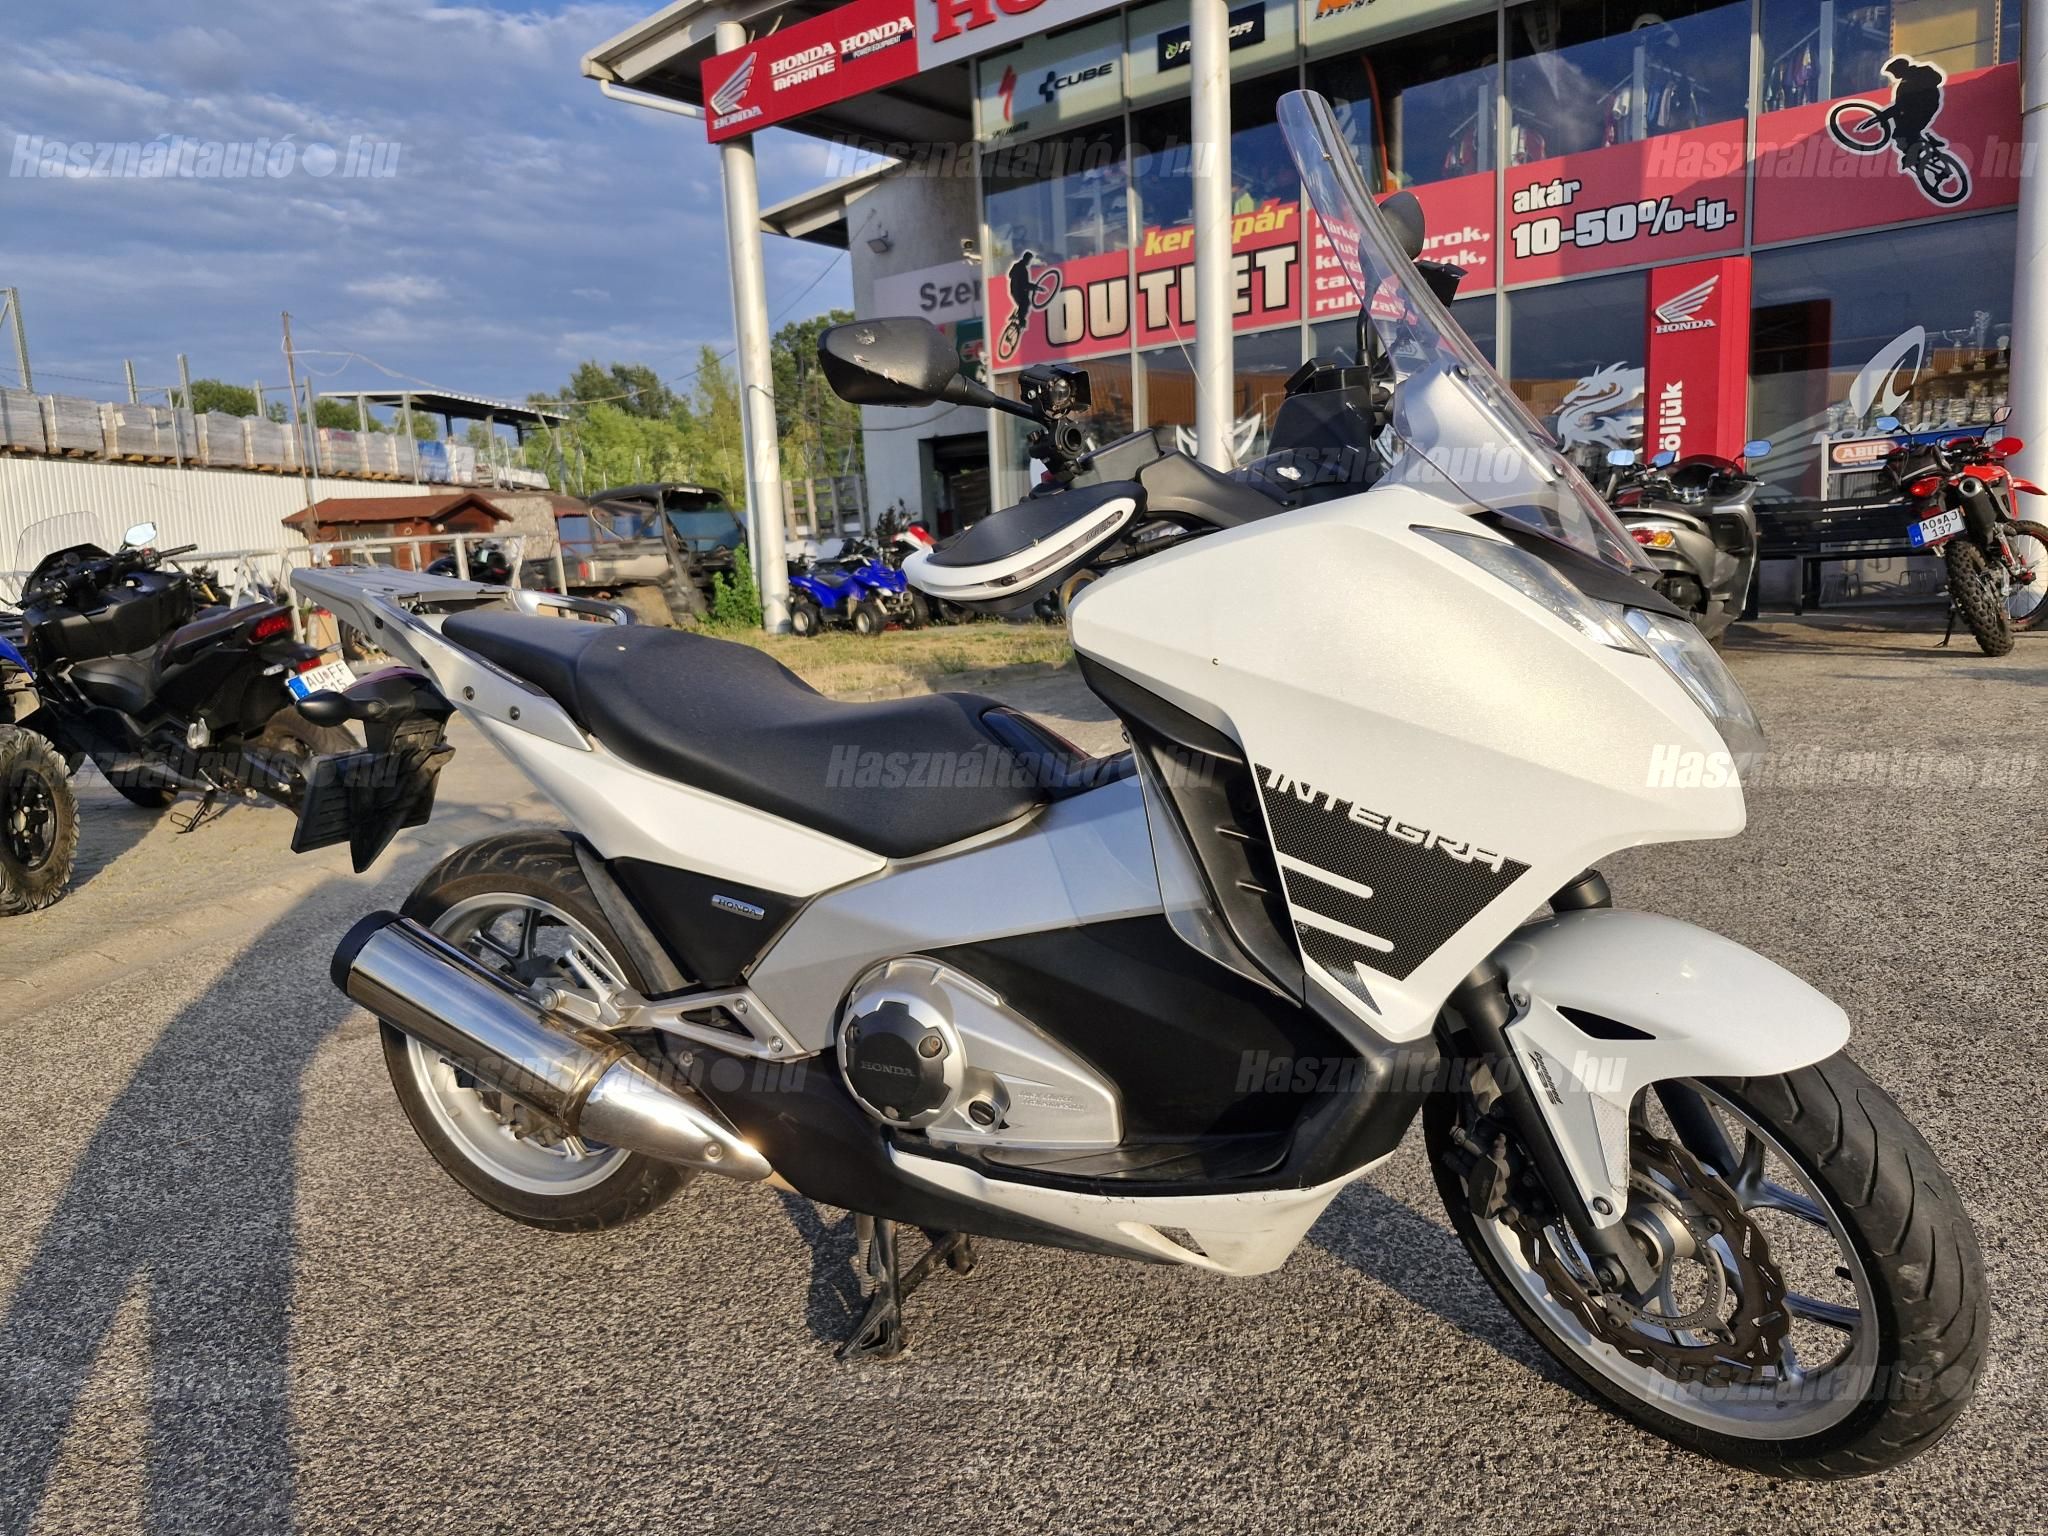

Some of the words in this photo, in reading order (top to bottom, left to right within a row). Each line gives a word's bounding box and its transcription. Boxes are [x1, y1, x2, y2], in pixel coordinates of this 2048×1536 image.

[839, 16, 914, 54] HONDA
[770, 42, 836, 76] HONDA
[773, 59, 836, 92] MARINE
[1054, 63, 1112, 90] CUBE
[712, 105, 763, 130] HONDA
[1513, 178, 1581, 213] akár
[1144, 205, 1294, 257] kerpár
[1512, 195, 1736, 258] 10-50%-ig.
[1655, 318, 1717, 334] HONDA
[1659, 380, 1686, 462] öljük
[1842, 443, 1890, 459] ABUS
[1931, 523, 1952, 538] 137
[321, 679, 347, 692] 15
[1265, 768, 1506, 874] INTEGRA
[719, 898, 757, 916] HONDA
[860, 1060, 916, 1078] HONDA
